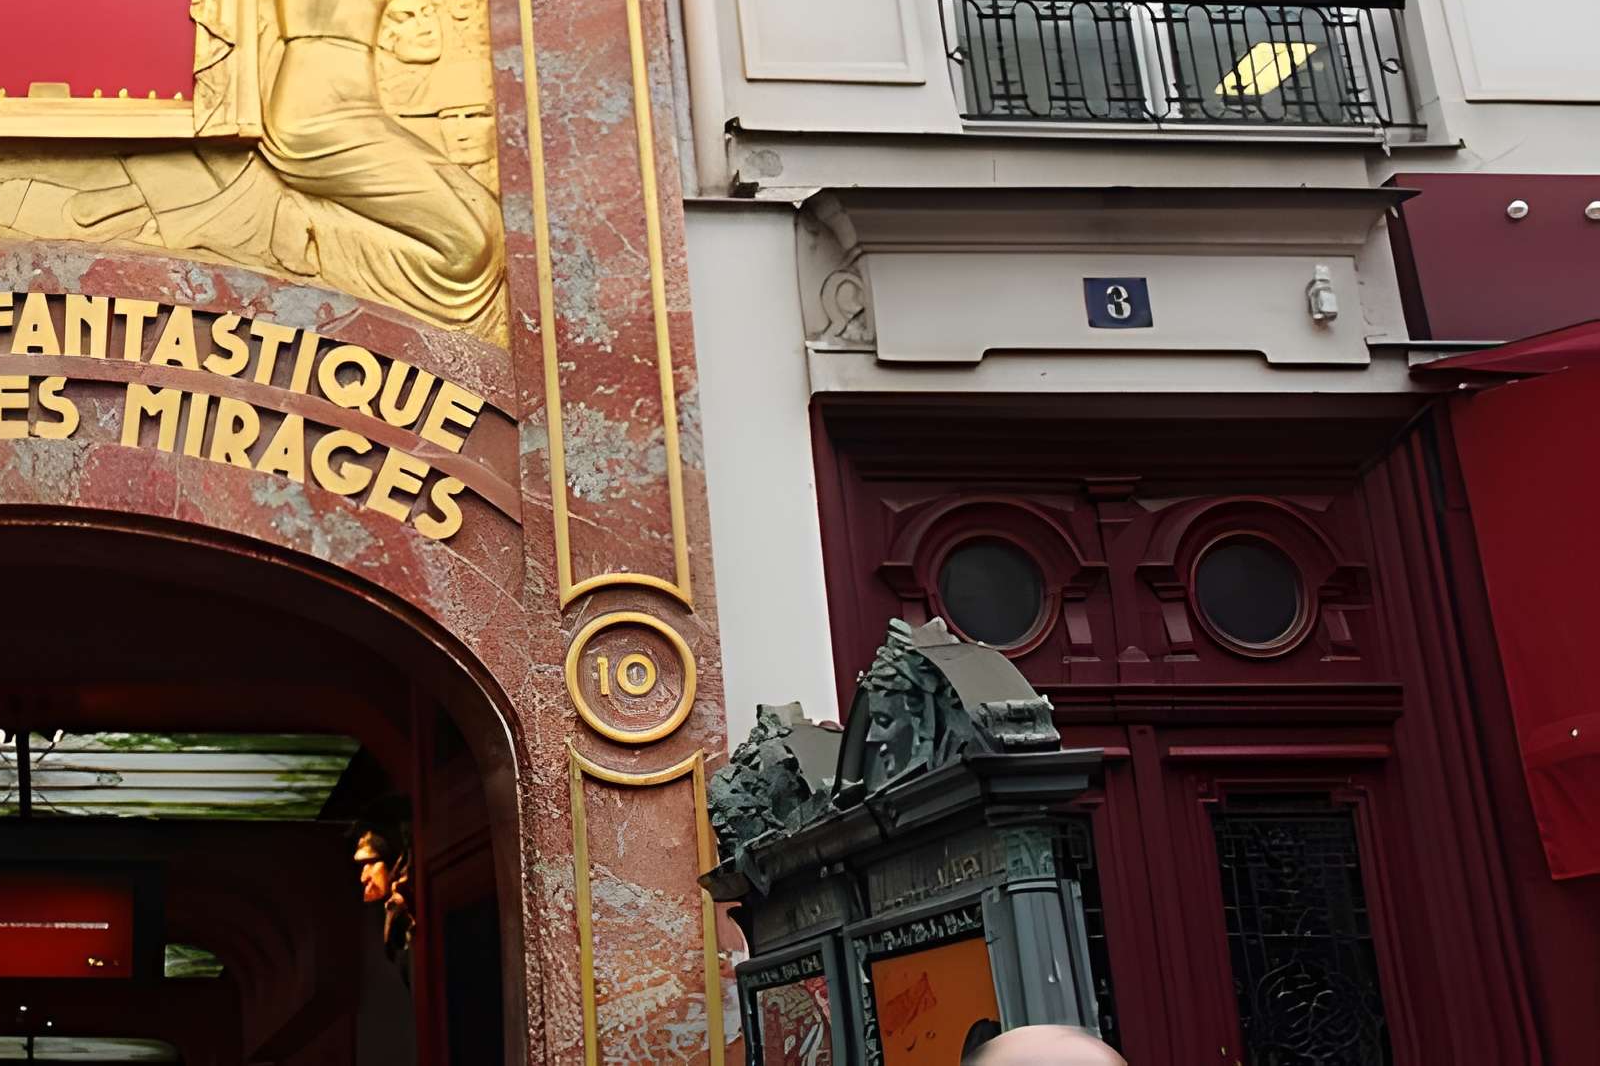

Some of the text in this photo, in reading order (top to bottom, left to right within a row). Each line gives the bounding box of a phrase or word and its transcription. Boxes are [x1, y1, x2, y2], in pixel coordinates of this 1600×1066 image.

[1106, 284, 1132, 320] 3
[120, 382, 466, 541] MIRAGES
[596, 652, 657, 696] 10
